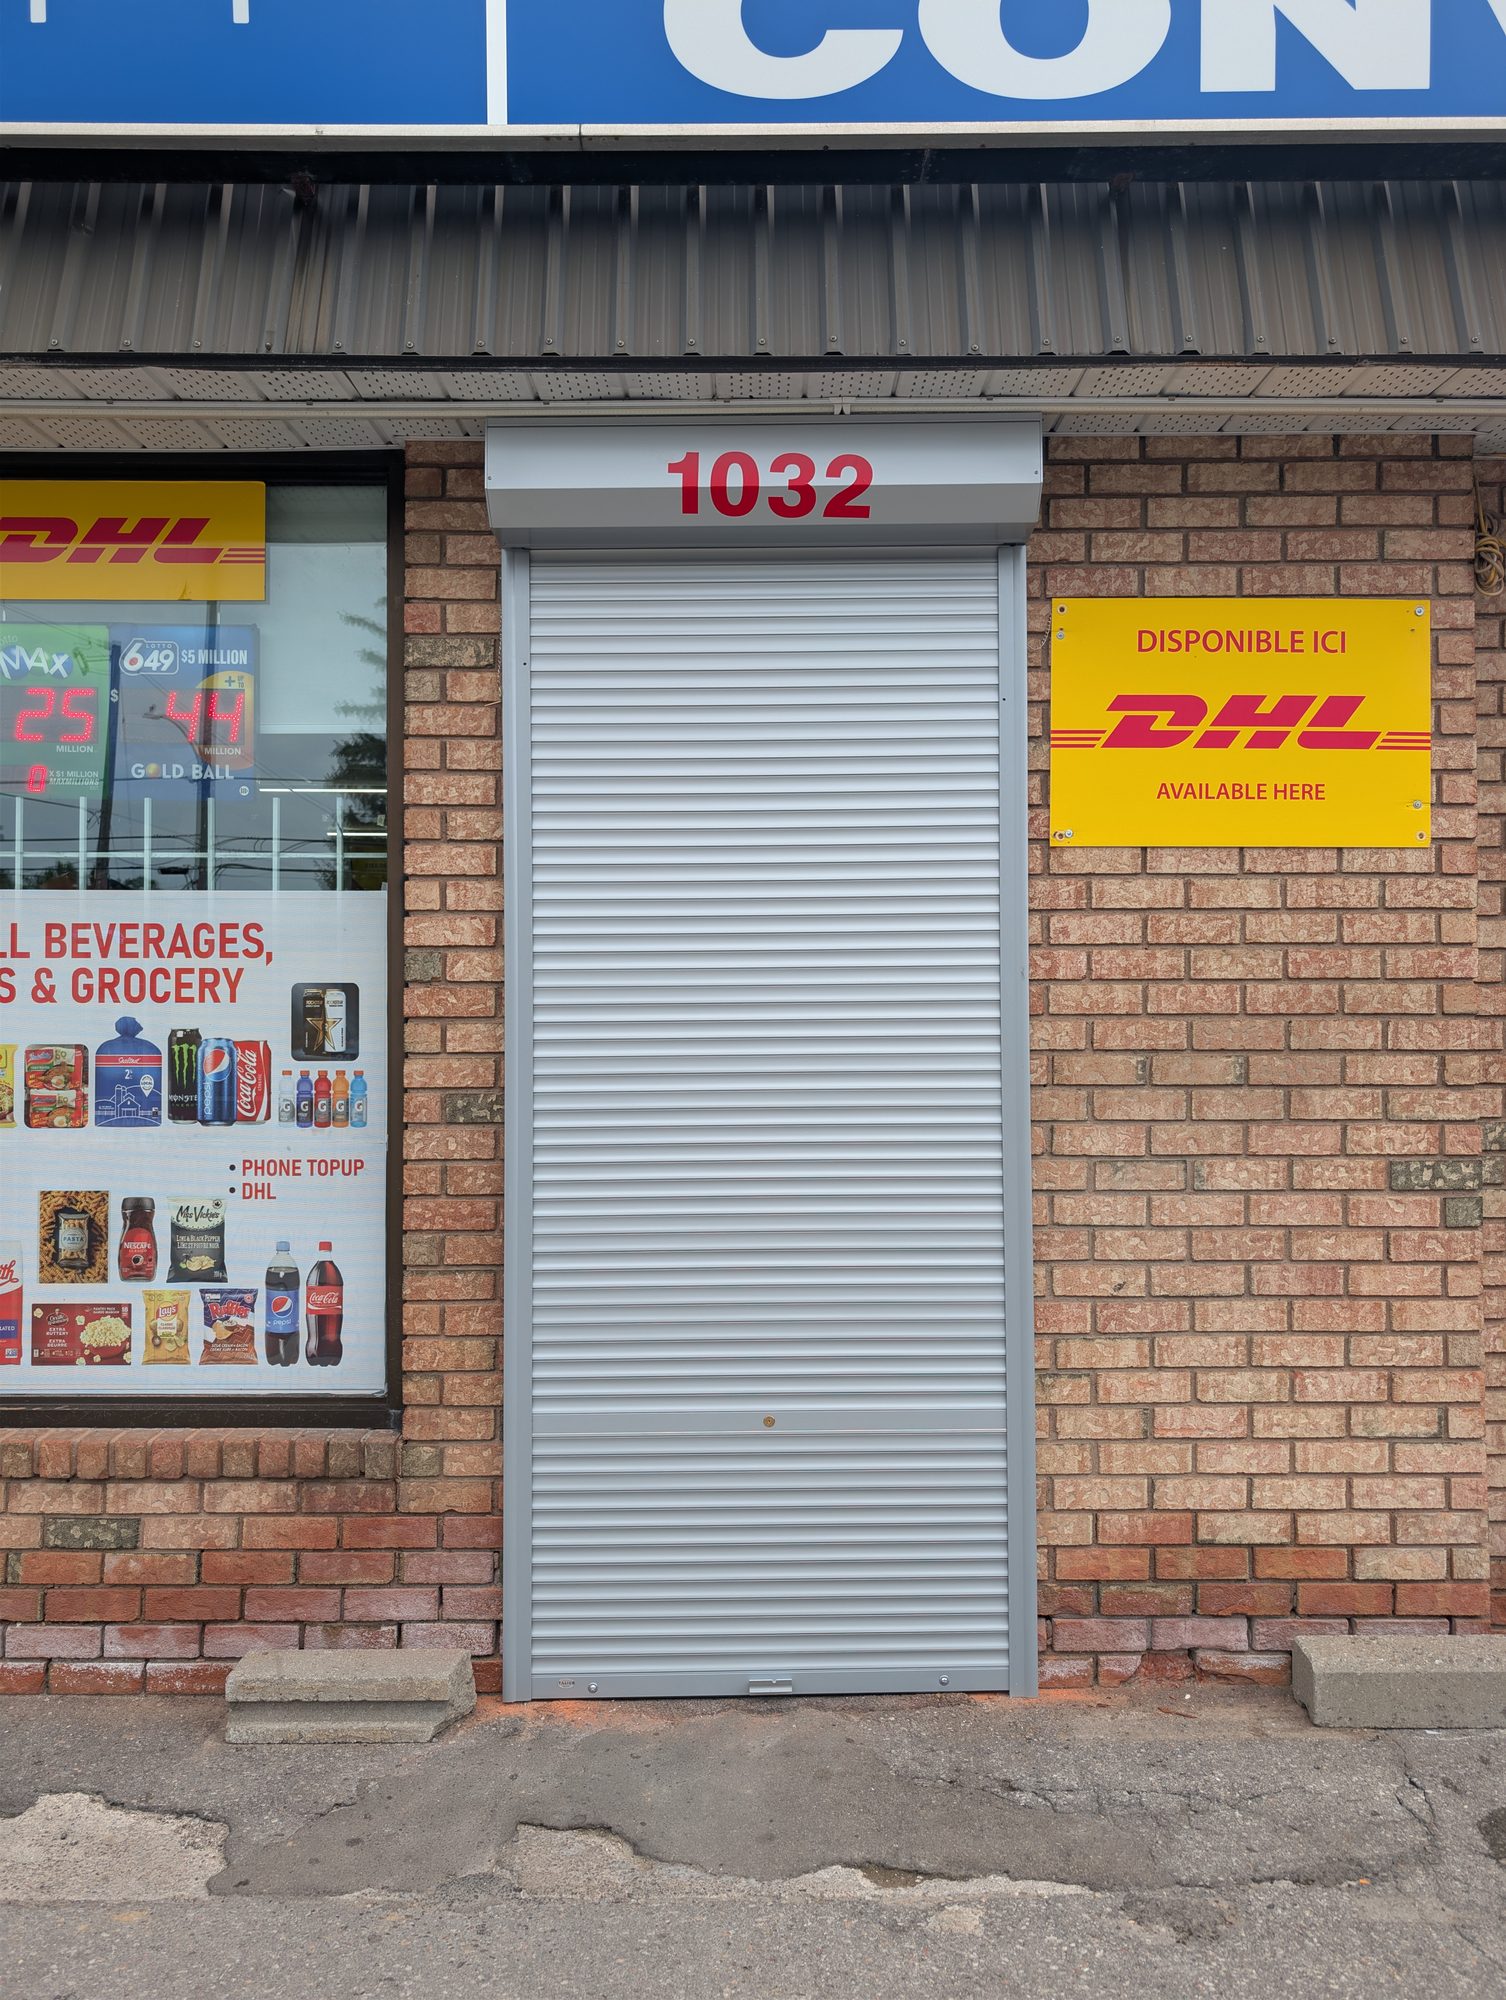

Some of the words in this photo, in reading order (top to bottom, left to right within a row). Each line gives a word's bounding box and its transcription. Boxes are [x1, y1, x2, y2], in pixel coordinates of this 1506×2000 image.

[663, 0, 1506, 100] CON
[667, 451, 873, 518] 1032
[0, 517, 224, 564] DHL
[1137, 629, 1304, 654] DISPONIBLE
[1312, 630, 1346, 654] ICI
[123, 642, 175, 671] 649
[181, 649, 196, 664] $5
[198, 649, 248, 665] MILLION
[110, 688, 119, 703] $
[15, 687, 95, 743] 25
[166, 691, 244, 743] 44
[1100, 694, 1382, 750] DHL
[56, 745, 94, 753] MILLION
[204, 747, 242, 756] MILLION
[27, 764, 48, 793] 0
[66, 770, 99, 778] MILLION
[192, 763, 235, 780] BALL
[1156, 782, 1267, 800] AVAILABLE
[1273, 783, 1326, 800] HERE
[45, 922, 273, 966] BEVERAGES,
[31, 966, 58, 1004] &
[71, 967, 245, 1004] GROCERY
[168, 1094, 198, 1103] MONSTE
[203, 1082, 213, 1116] pepsi
[242, 1159, 302, 1177] PHONE
[307, 1159, 365, 1177] TOPUP
[242, 1182, 277, 1200] DHL
[272, 1318, 292, 1326] pepsi
